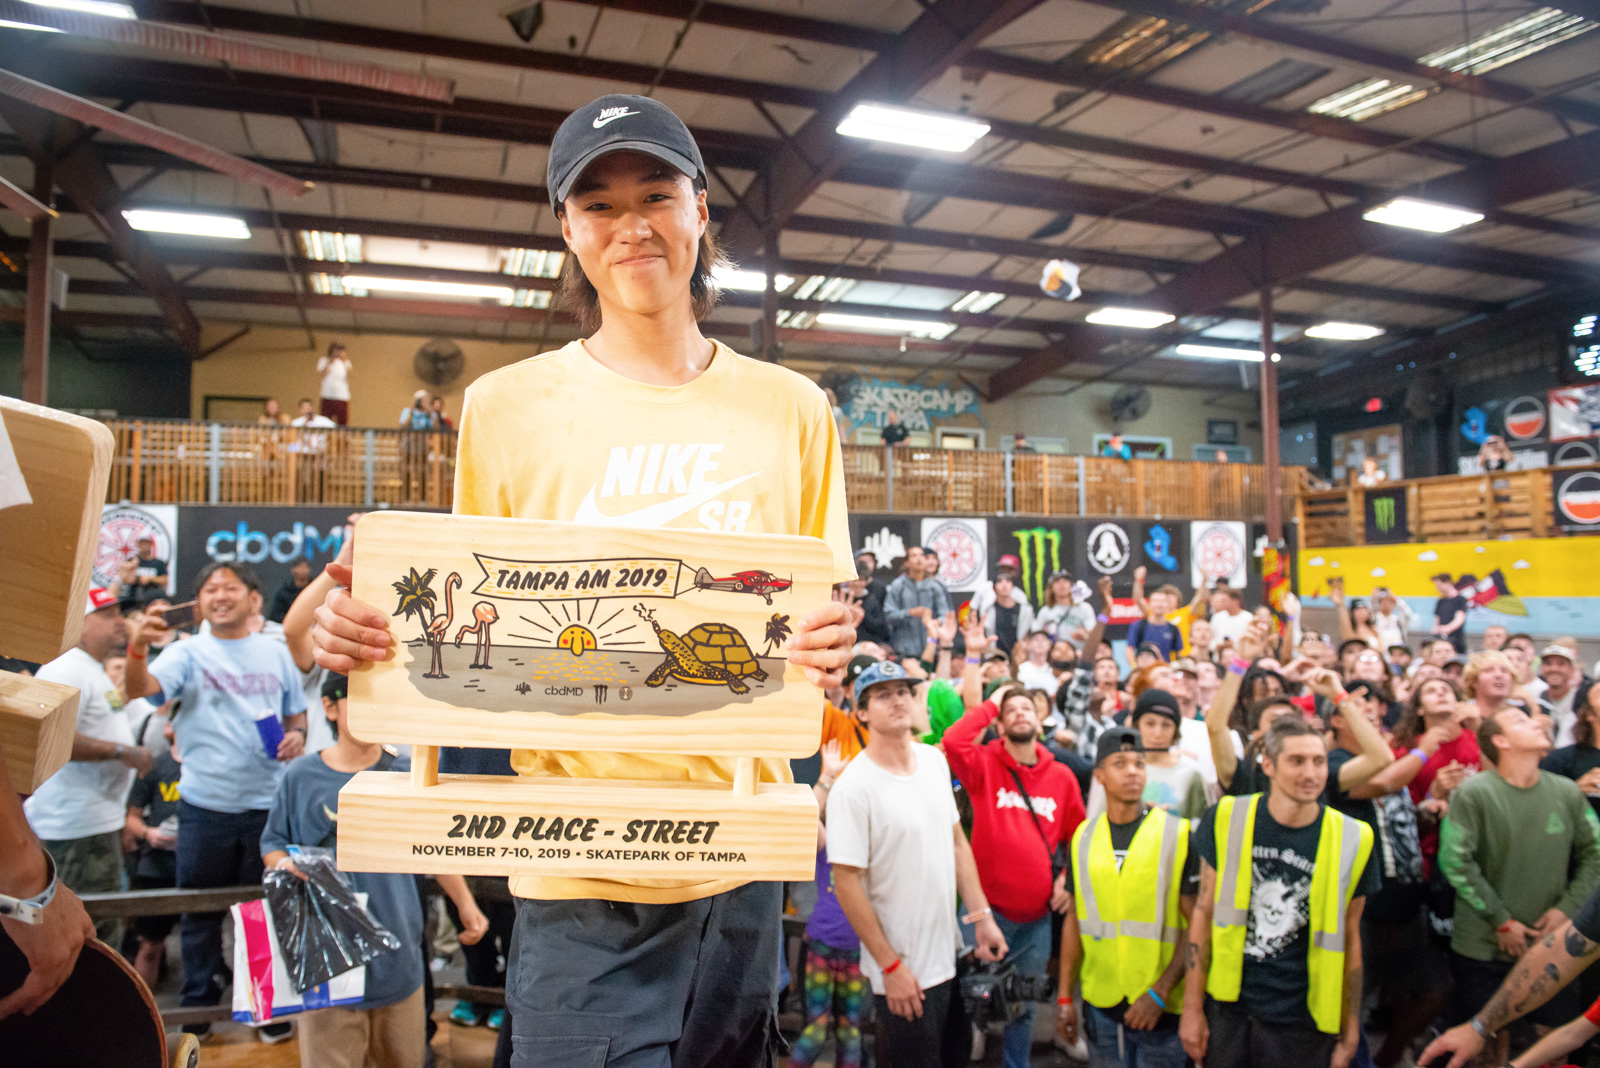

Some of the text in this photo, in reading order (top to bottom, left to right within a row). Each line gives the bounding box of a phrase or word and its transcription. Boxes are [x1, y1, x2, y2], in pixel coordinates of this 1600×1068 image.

[599, 106, 629, 119] NIKE
[600, 443, 724, 498] NIKE
[697, 501, 751, 532] SB
[205, 521, 352, 563] cbdM
[496, 568, 667, 590] TAMPA AM 2019
[544, 685, 583, 696] cbdMD
[447, 814, 506, 839] 2ND
[512, 816, 599, 842] PLACE
[622, 819, 720, 845] STREET
[412, 845, 747, 862] NOVEMBER 7-10, 2019 SKATEPARK OF TAMPA
